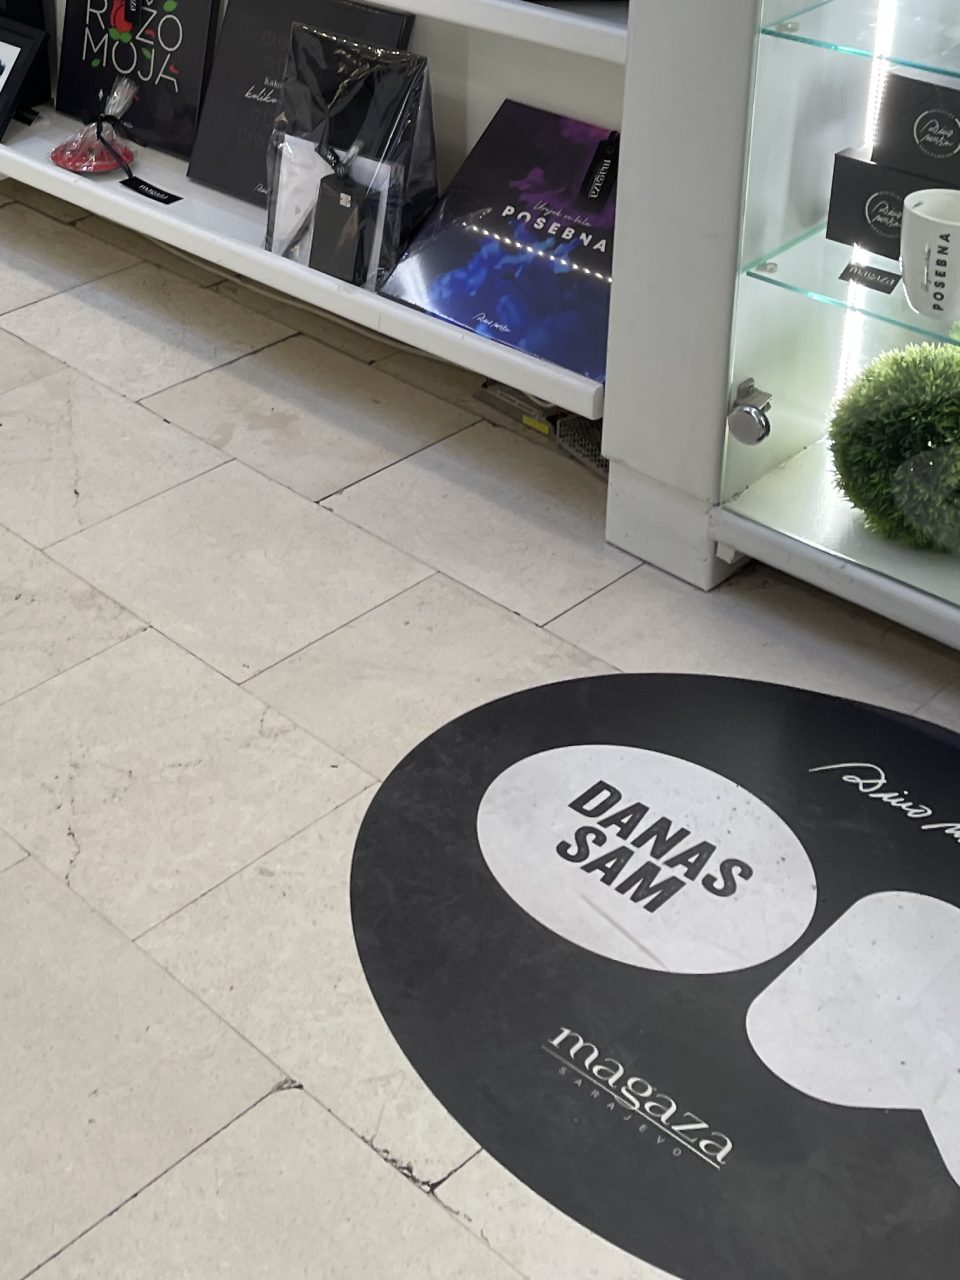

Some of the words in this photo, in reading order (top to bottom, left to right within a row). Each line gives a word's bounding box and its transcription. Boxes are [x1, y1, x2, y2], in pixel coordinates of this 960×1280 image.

[82, 26, 179, 93] MOJA
[244, 84, 278, 103] koliko
[590, 159, 611, 199] magaza
[502, 205, 607, 253] POSEBNA
[932, 232, 951, 311] POSEBNA
[555, 825, 687, 914] SAM
[567, 780, 754, 898] DANAS
[545, 1026, 735, 1167] magaza
[558, 1066, 683, 1158] SARAJEVO
